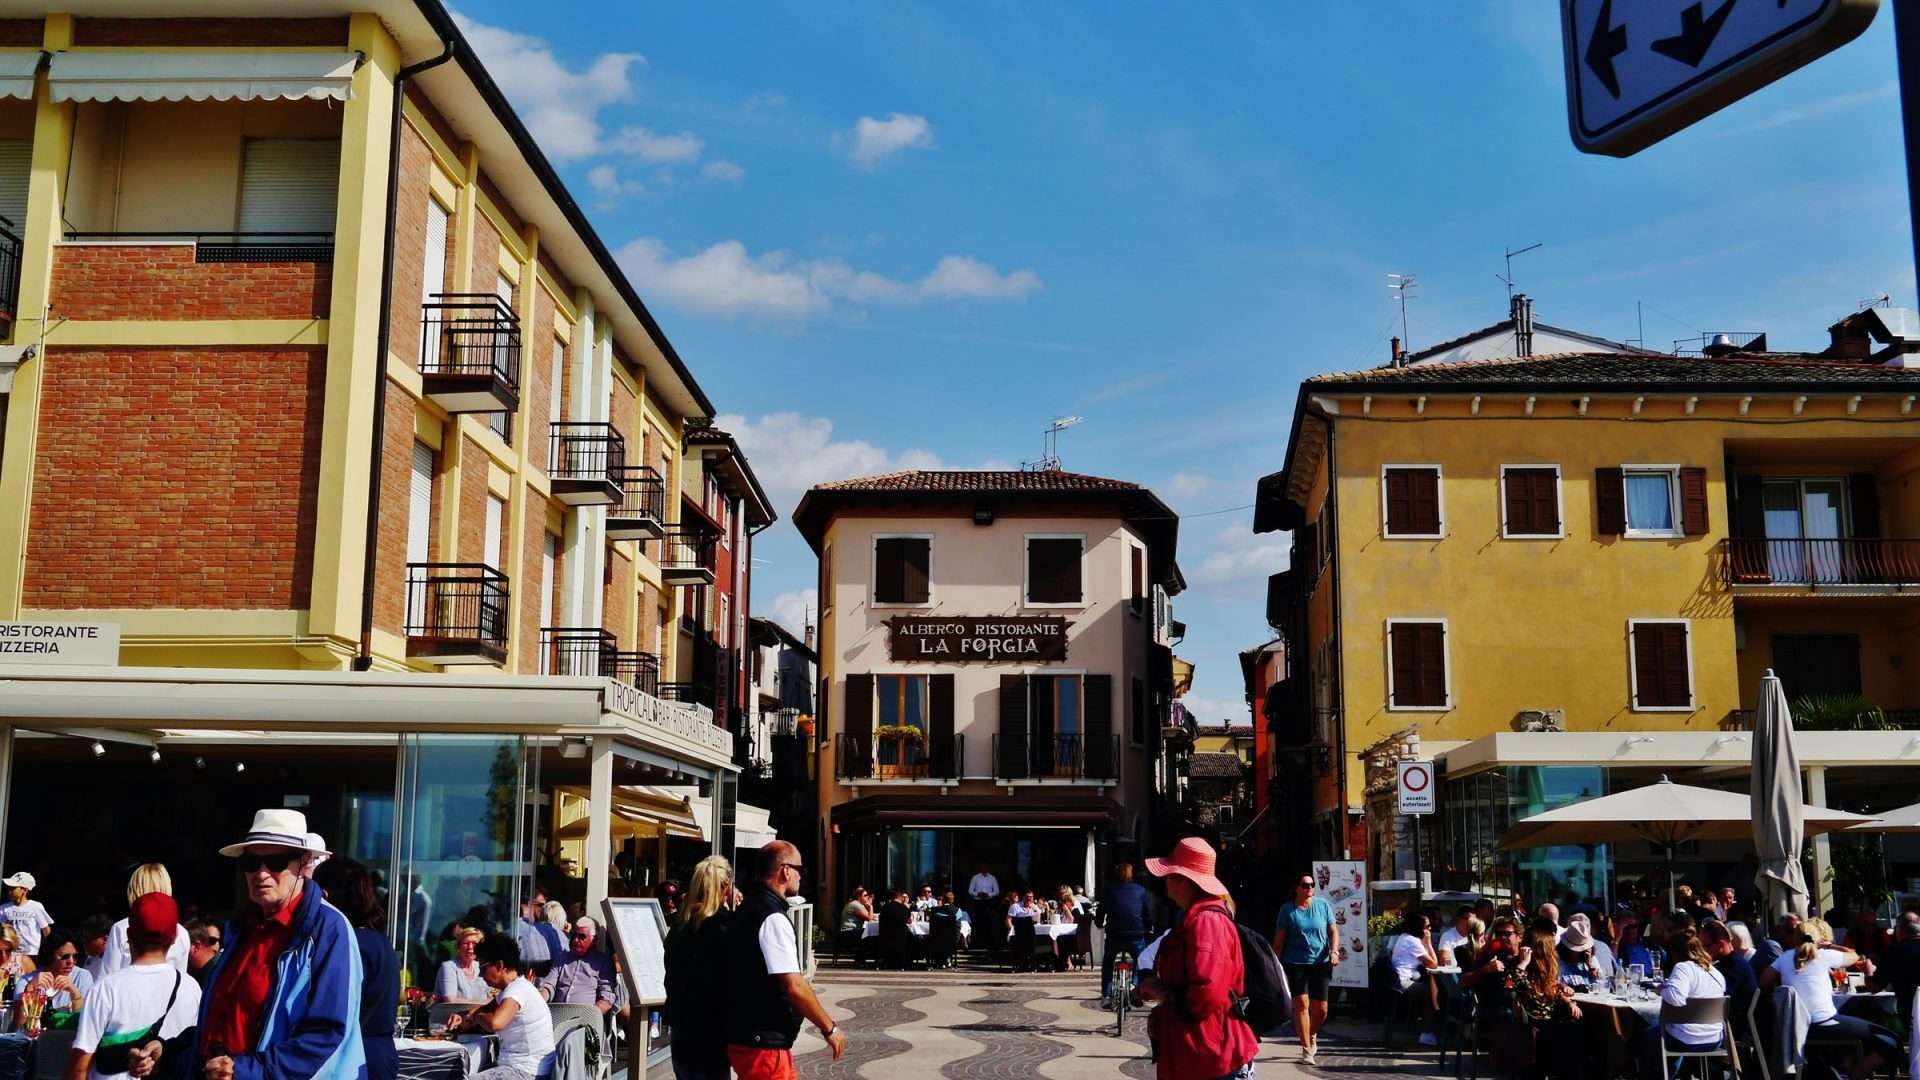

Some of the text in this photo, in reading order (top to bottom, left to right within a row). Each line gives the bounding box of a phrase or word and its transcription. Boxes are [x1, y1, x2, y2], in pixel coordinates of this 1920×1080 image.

[0, 625, 98, 638] RISTORANTE
[900, 623, 1059, 636] ALBERGO RISTORANTE
[920, 637, 1040, 660] LA FORGIA
[611, 680, 653, 722] TROPICAL
[659, 702, 671, 729] BAR
[673, 708, 706, 744] RISTORANTE
